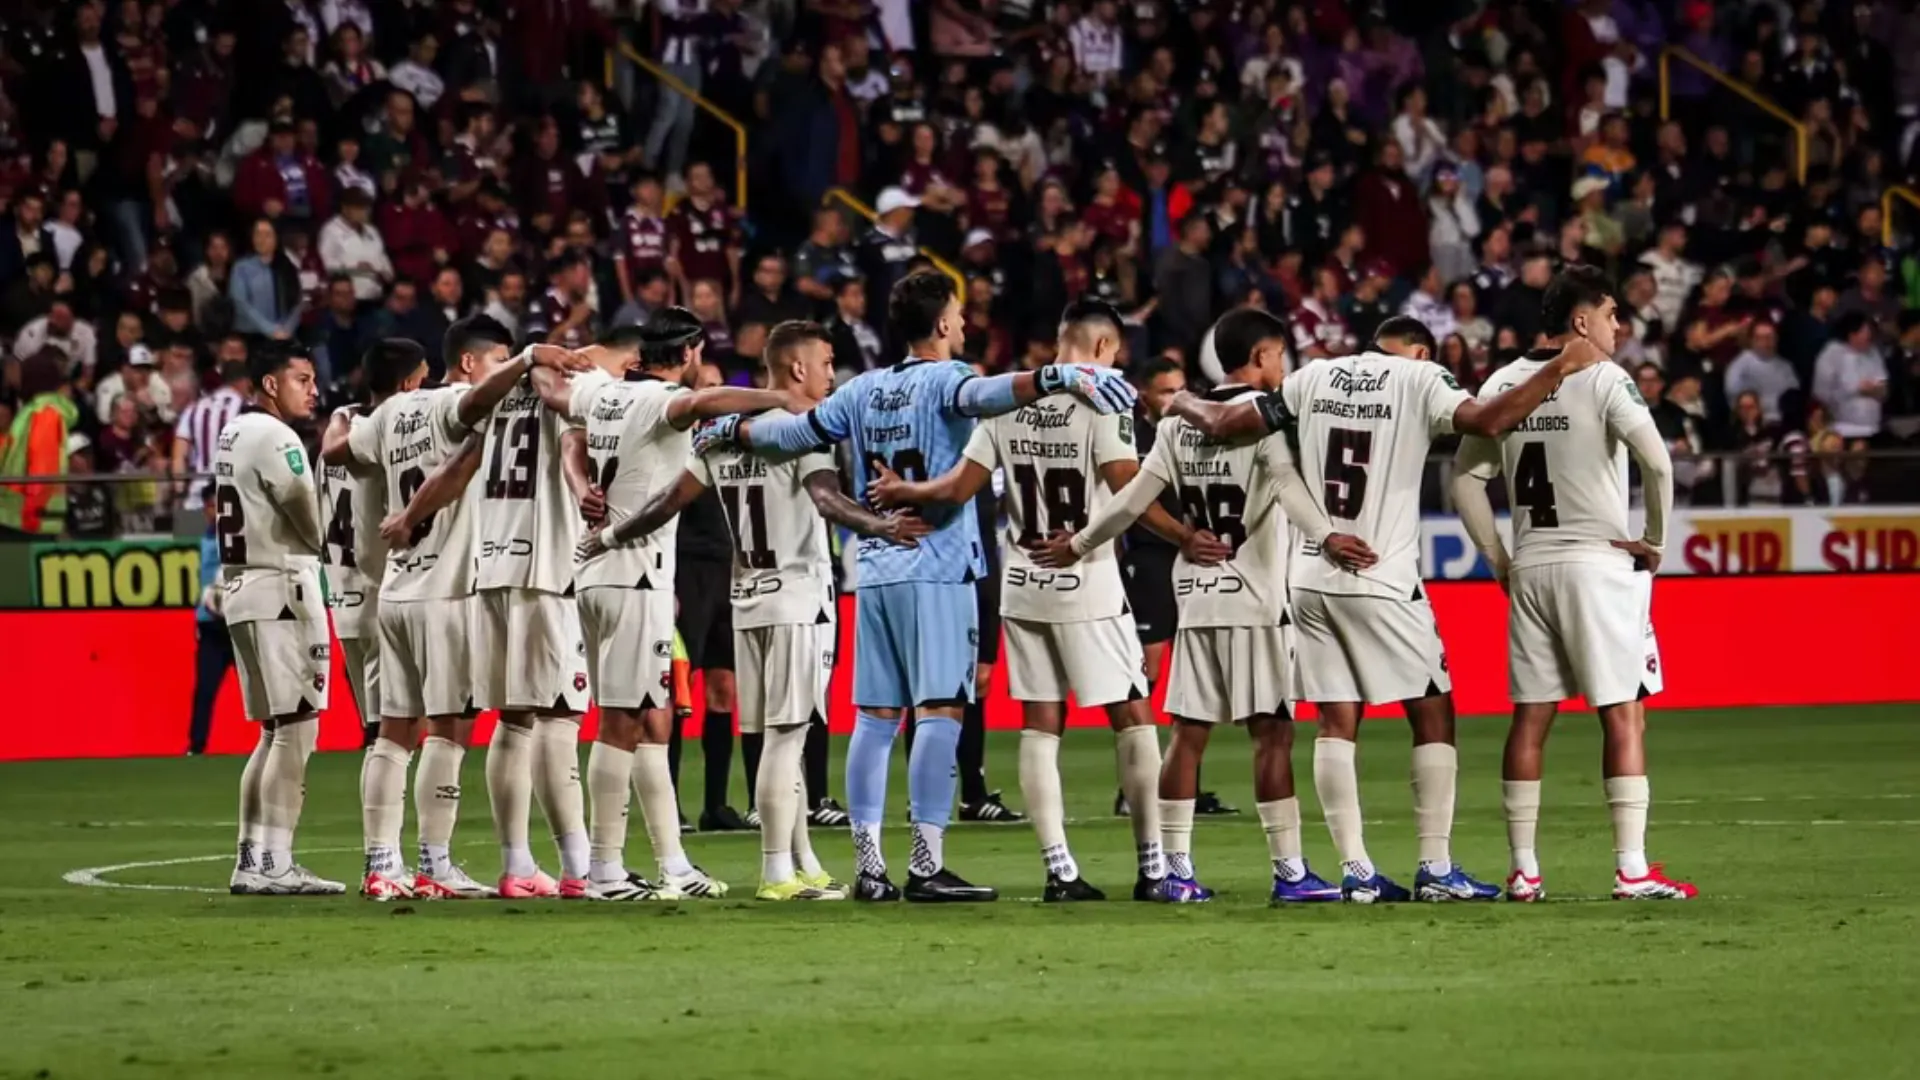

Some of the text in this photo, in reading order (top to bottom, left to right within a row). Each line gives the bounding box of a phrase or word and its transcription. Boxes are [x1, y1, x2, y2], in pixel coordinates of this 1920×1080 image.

[1312, 398, 1392, 419] BORGES MORA
[486, 416, 540, 499] 13
[1324, 427, 1372, 521] 5
[1515, 441, 1559, 528] 4
[482, 539, 533, 558] BYD
[719, 485, 777, 570] 11
[1007, 566, 1080, 592] BYD
[1177, 576, 1243, 596] BYD
